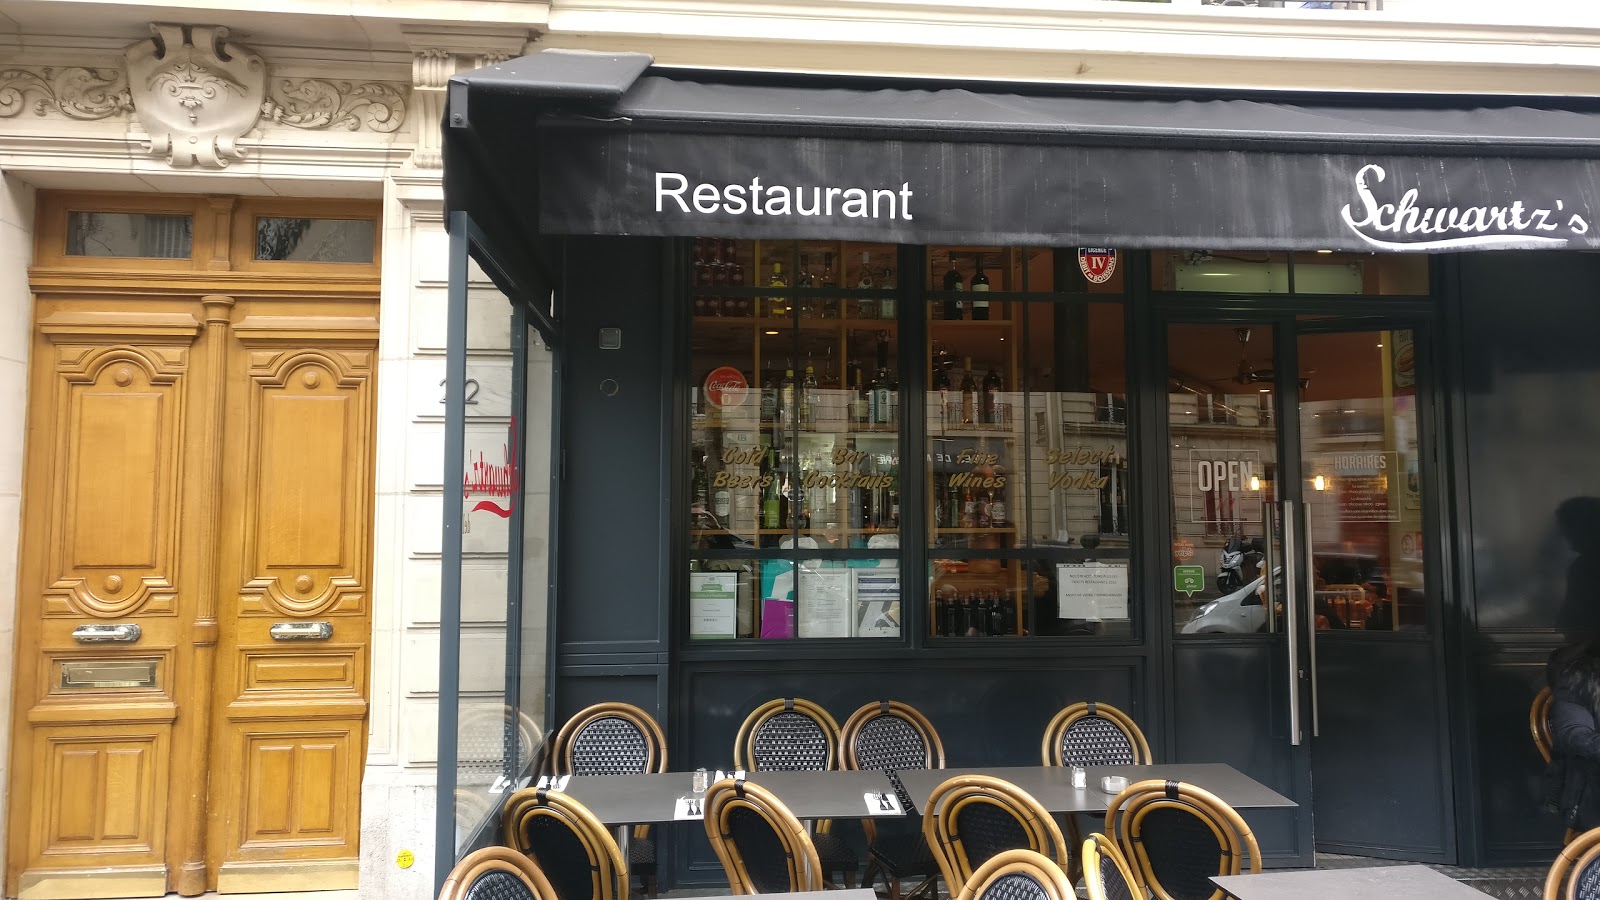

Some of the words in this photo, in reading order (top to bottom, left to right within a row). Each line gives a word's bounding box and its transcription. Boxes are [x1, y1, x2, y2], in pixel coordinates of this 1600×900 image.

[655, 172, 913, 220] Restaurant
[1341, 164, 1589, 235] Schwartz's
[1091, 256, 1106, 269] IV
[722, 446, 768, 465] Cold
[831, 447, 868, 465] Bar
[956, 448, 998, 466] Fine
[1045, 445, 1115, 466] Select
[1334, 455, 1387, 469] HORAIRES
[713, 470, 774, 489] Beers
[803, 470, 894, 489] Cocktails
[948, 472, 1006, 489] Wines
[1048, 471, 1109, 490] Vodka
[1198, 460, 1253, 492] OPEN
